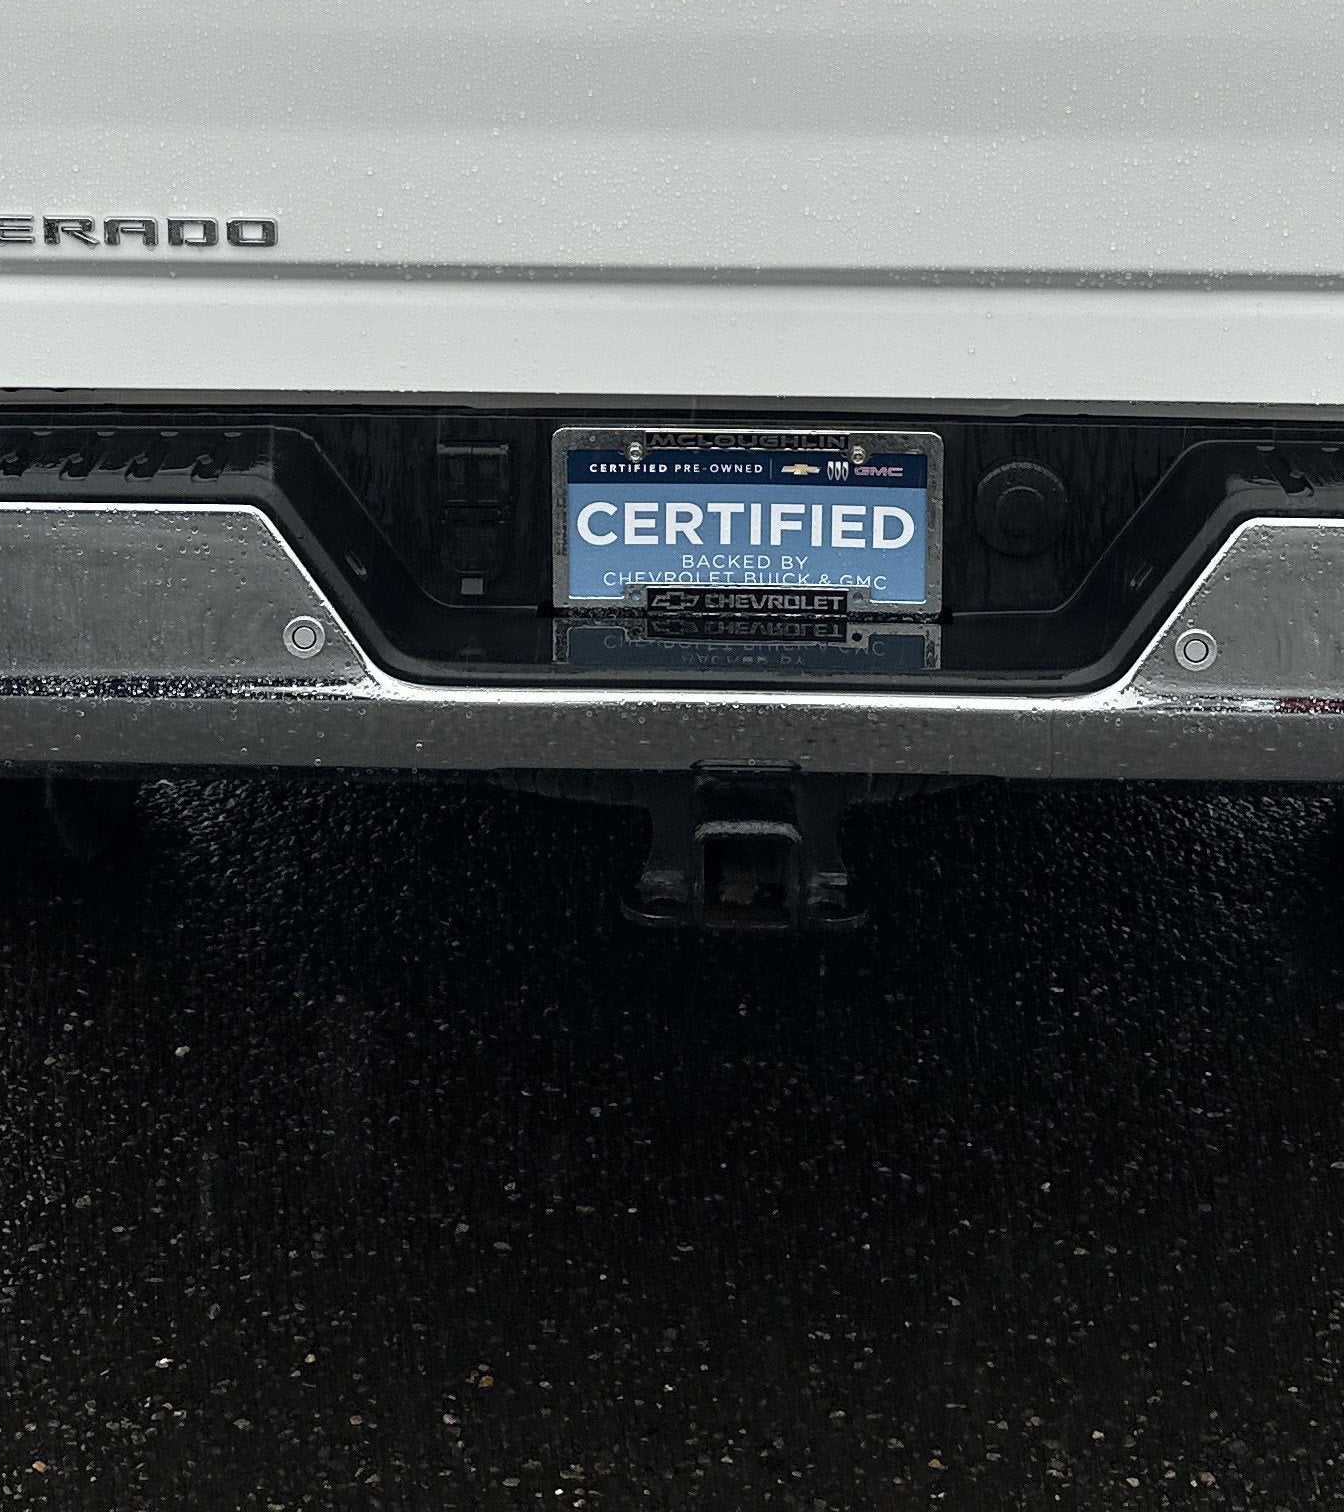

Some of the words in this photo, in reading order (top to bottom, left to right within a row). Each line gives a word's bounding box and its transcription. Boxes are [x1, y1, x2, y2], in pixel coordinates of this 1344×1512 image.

[649, 433, 846, 449] MCLOUGHLIN
[588, 463, 668, 474] CERTIFIED
[673, 463, 764, 475] PRE-OWNED
[854, 466, 904, 478] GMC
[575, 500, 916, 550] CERTIFIED
[681, 554, 771, 570] BACKED
[781, 555, 809, 570] BY
[603, 571, 735, 587] CHEVROLET
[744, 572, 810, 585] BUICK
[818, 573, 832, 586] &
[839, 574, 888, 591] GMC
[705, 593, 845, 610] CHEVROLET
